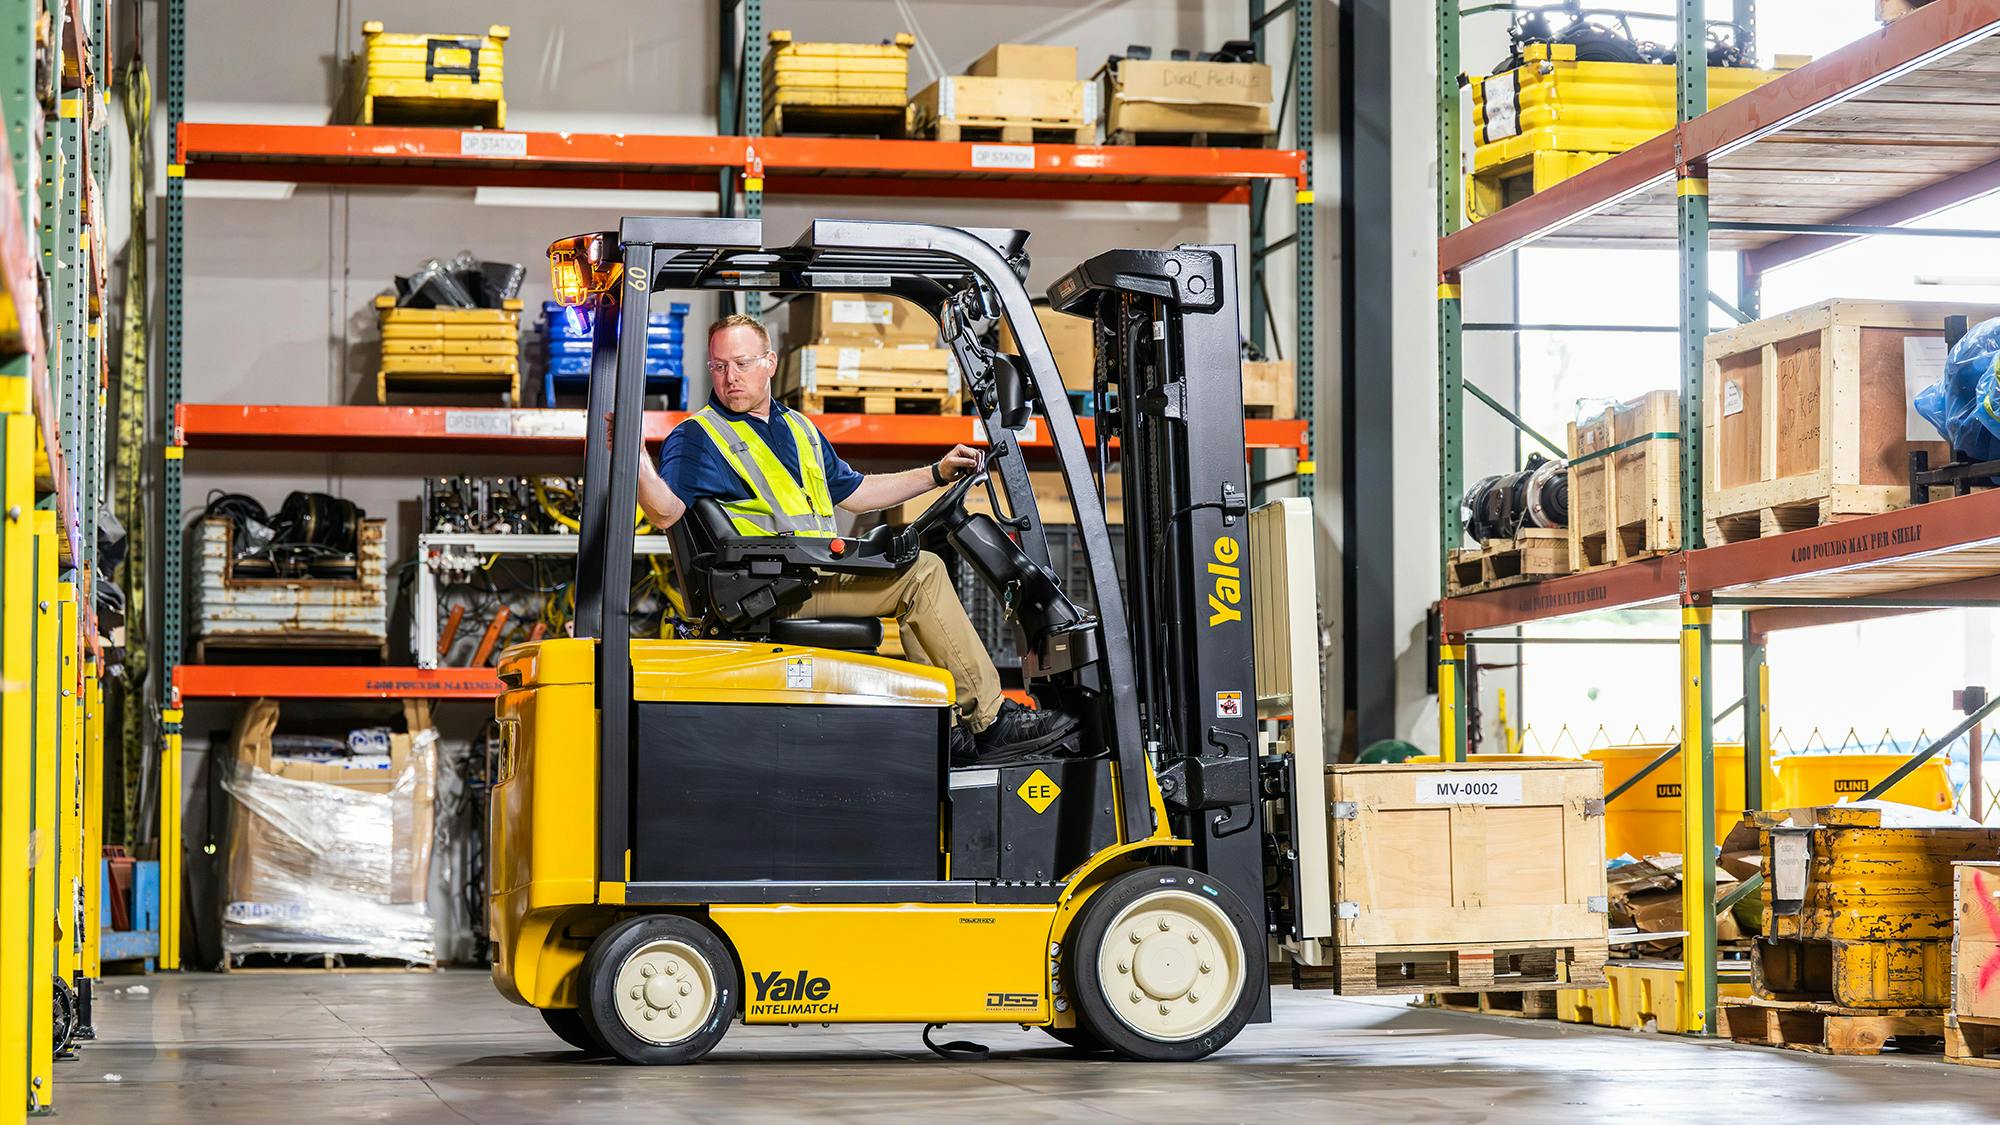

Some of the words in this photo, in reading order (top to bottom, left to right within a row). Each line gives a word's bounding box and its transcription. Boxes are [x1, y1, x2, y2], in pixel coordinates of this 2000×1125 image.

[991, 152, 1031, 162] STATION
[628, 267, 647, 292] 60
[1813, 540, 1846, 559] POUNDS
[1849, 535, 1868, 553] MAX
[1870, 532, 1889, 549] PER
[1892, 525, 1922, 544] SHELF
[1208, 536, 1241, 627] Yale
[1028, 786, 1050, 798] EE
[1437, 783, 1498, 795] MV-0002
[1657, 785, 1682, 797] ULIN
[1835, 780, 1868, 792] ULINE
[751, 970, 831, 1001] Yale
[987, 994, 1038, 1007] DSS
[751, 1004, 839, 1015] INTELIMATCH
